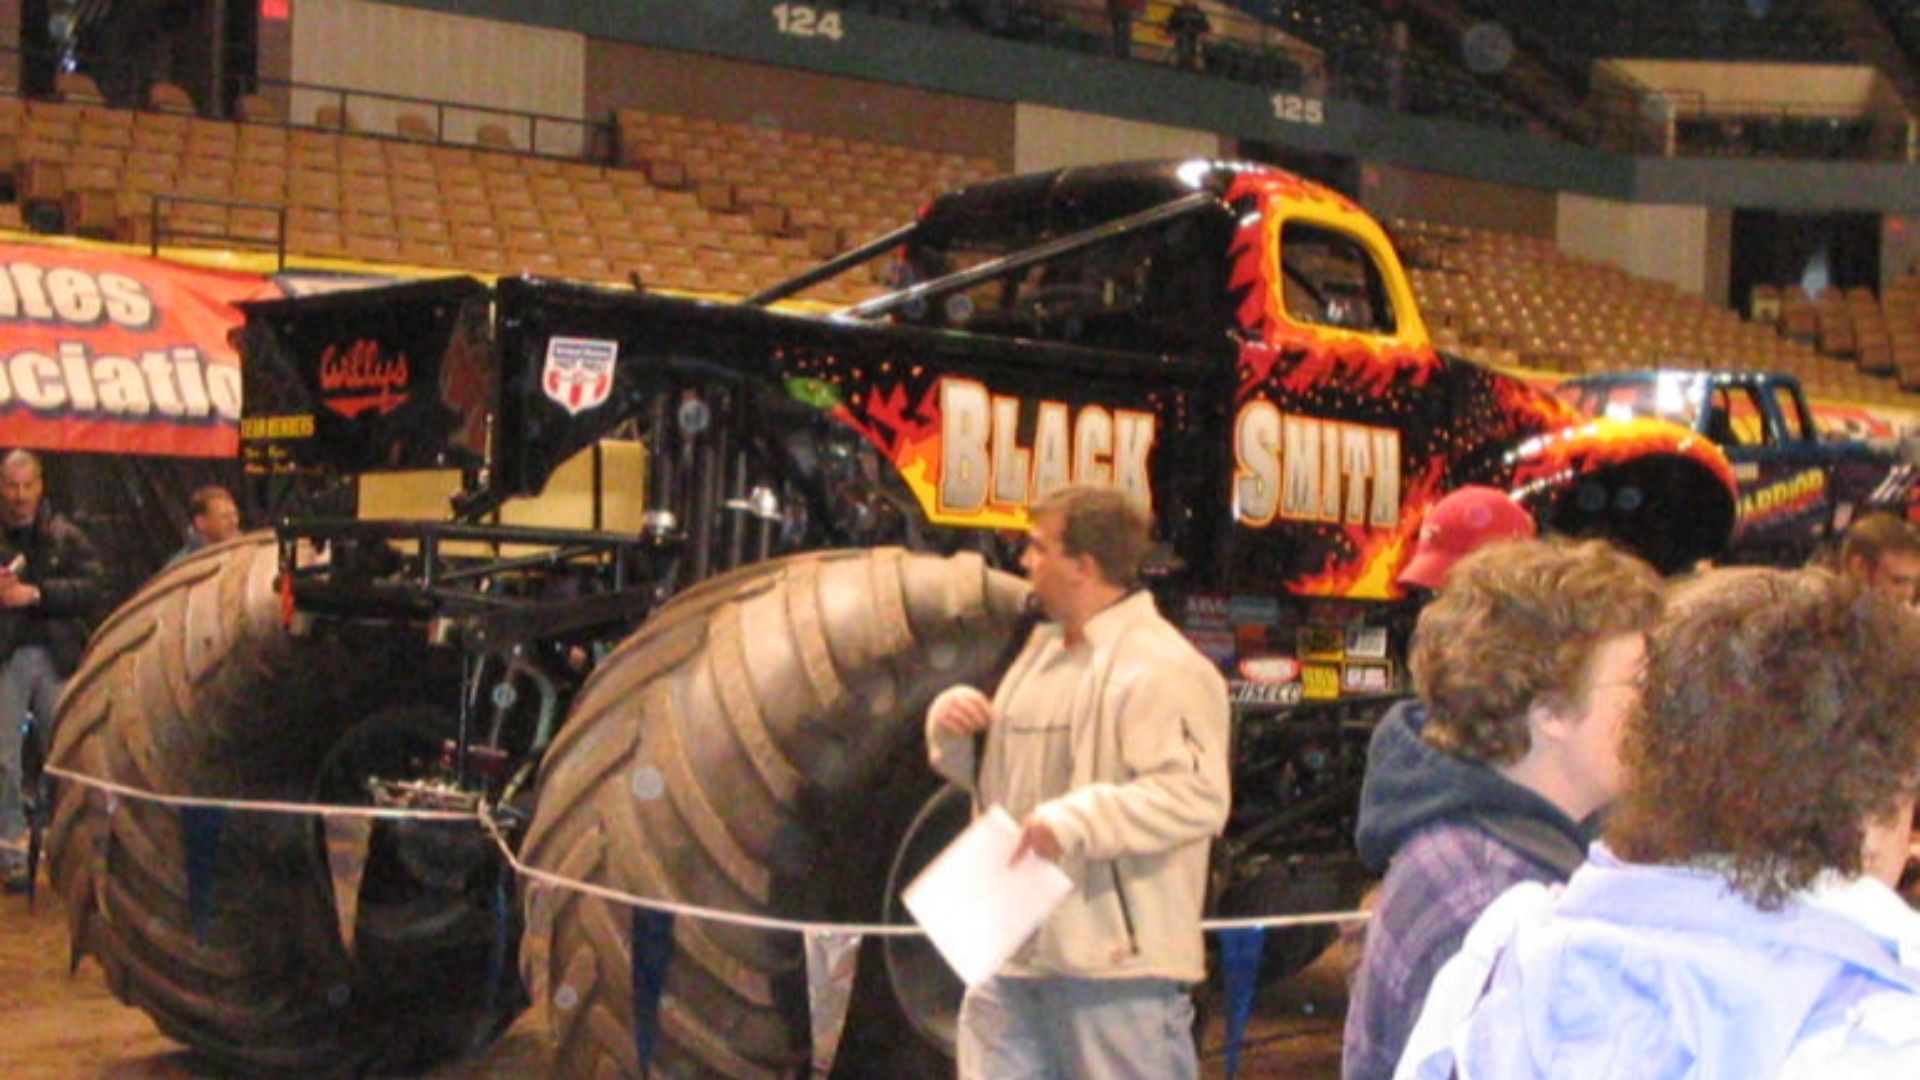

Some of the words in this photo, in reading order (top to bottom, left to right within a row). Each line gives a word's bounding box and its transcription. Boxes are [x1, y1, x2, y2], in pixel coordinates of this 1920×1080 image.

[772, 3, 843, 40] 124
[1272, 94, 1323, 124] 125
[0, 341, 242, 422] ciatio
[320, 339, 409, 404] Willys
[1233, 399, 1400, 527] SMITH
